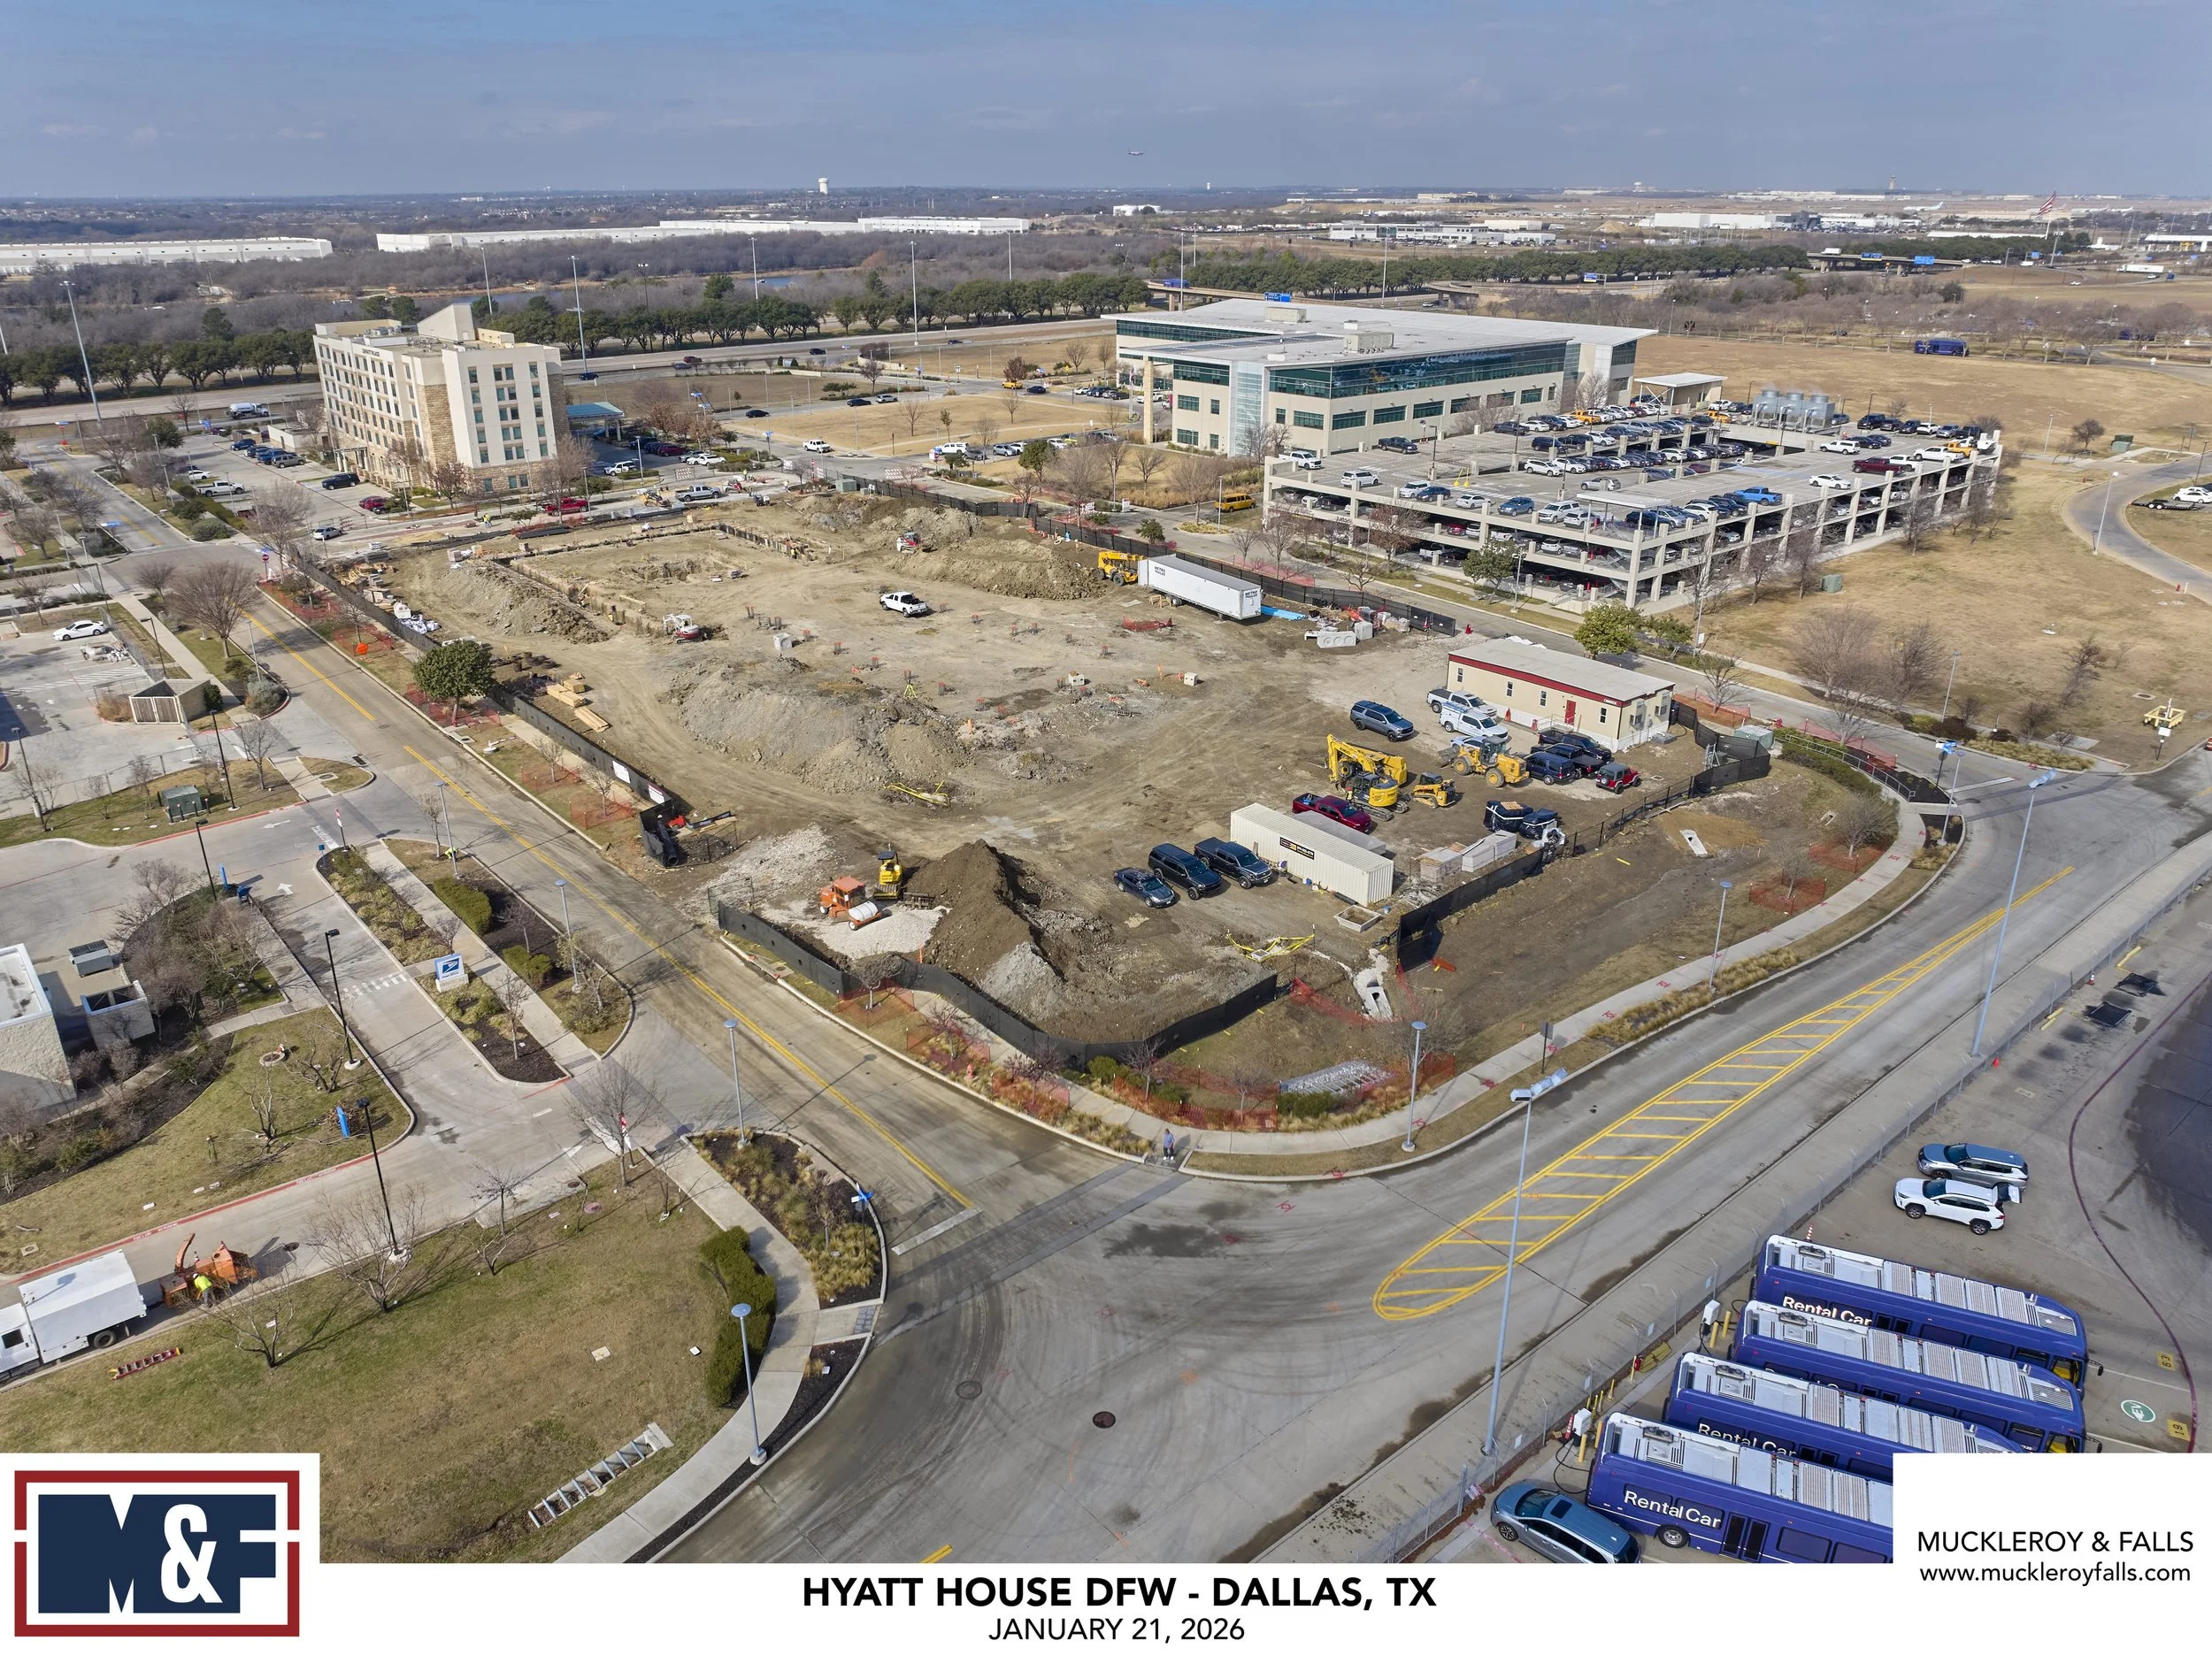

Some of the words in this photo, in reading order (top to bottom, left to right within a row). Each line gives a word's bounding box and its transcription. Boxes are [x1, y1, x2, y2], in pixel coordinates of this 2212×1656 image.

[1782, 1296, 1838, 1319] Rental
[1840, 1310, 1873, 1326] Car
[1698, 1422, 1758, 1448] Rental
[1624, 1490, 1684, 1519] Rental
[1686, 1507, 1722, 1528] Car
